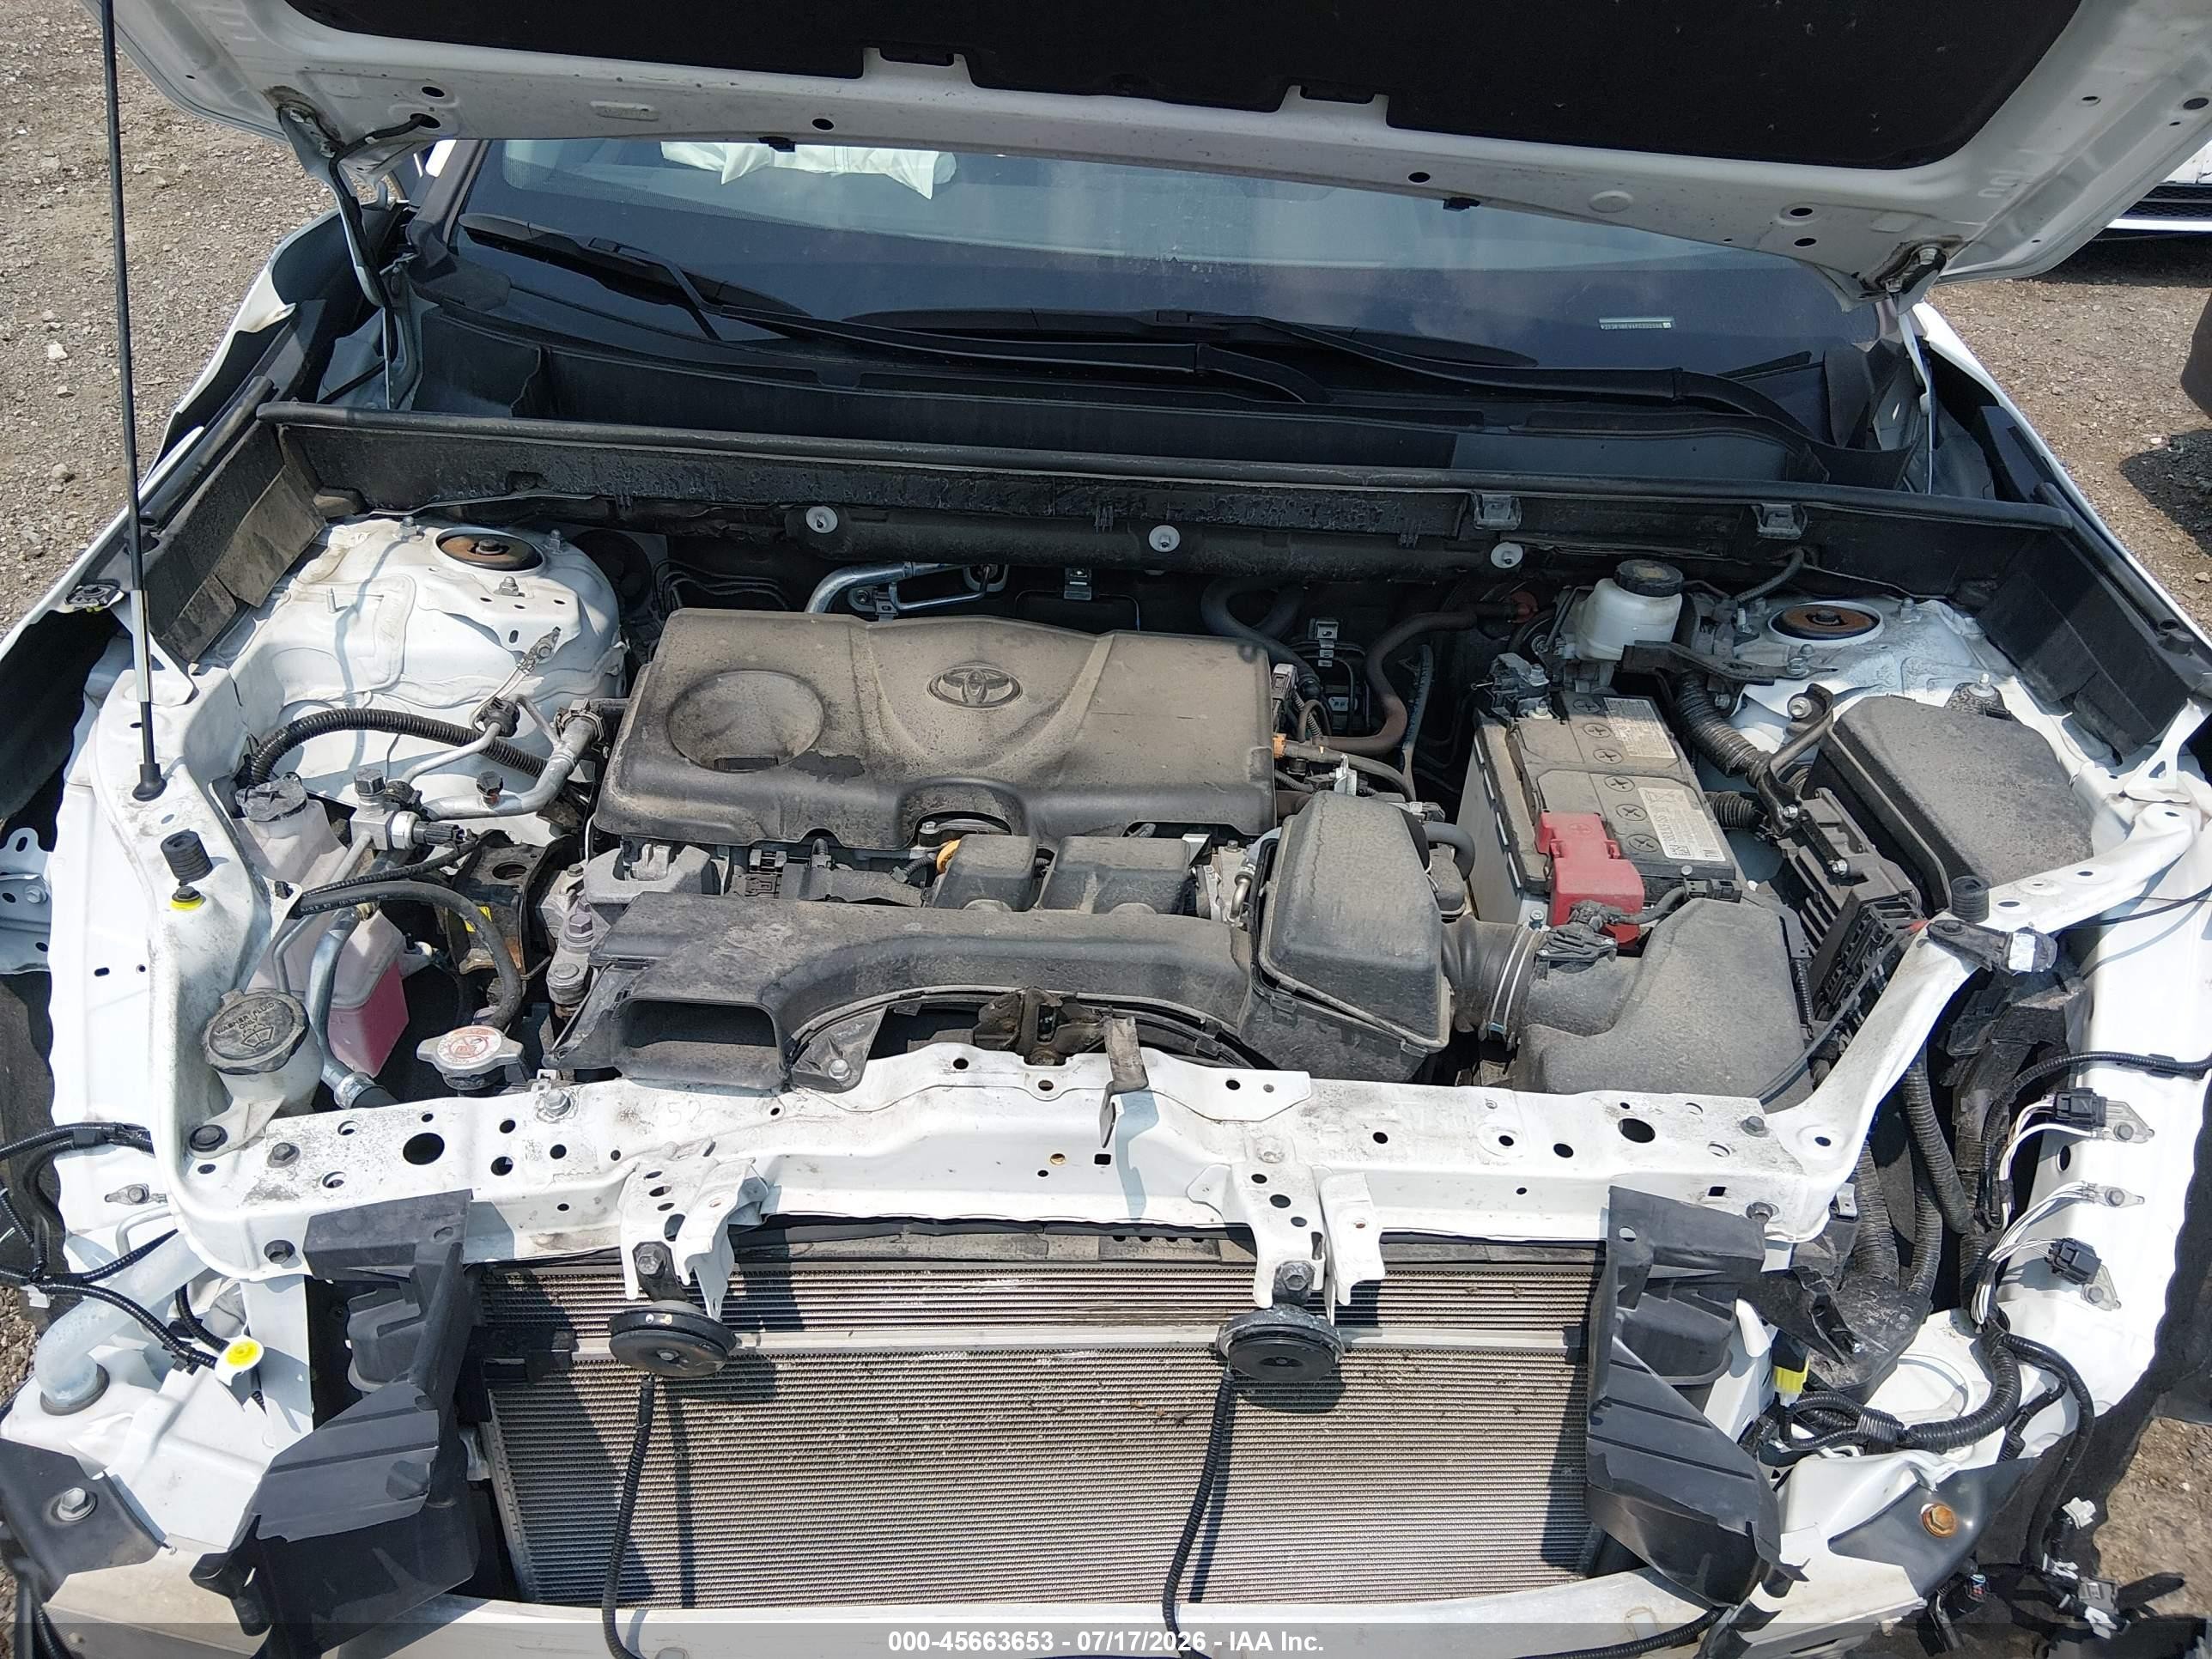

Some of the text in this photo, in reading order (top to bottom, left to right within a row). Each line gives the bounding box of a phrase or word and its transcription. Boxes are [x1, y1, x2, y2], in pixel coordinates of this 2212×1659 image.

[214, 1001, 276, 1035] WASHER FLUID
[238, 1016, 258, 1030] ONLY
